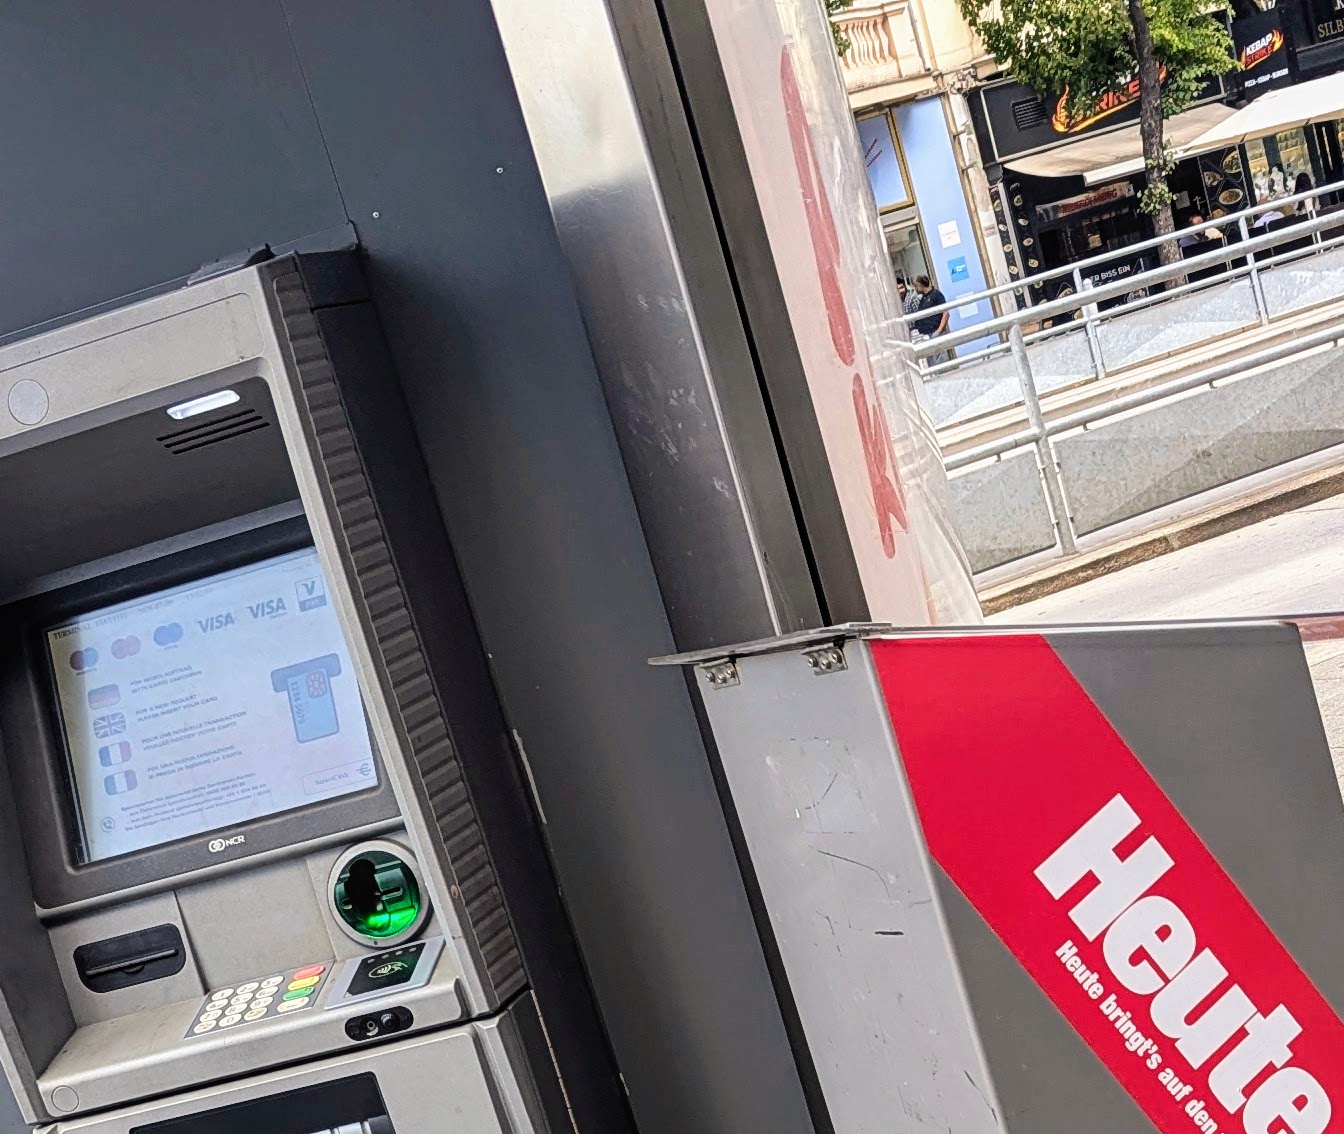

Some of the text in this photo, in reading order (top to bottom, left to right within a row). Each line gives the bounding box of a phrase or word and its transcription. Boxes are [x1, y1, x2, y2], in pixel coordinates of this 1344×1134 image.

[1246, 33, 1273, 57] KEBAP
[247, 596, 287, 620] VISA
[196, 612, 235, 634] VISA
[225, 834, 245, 847] NCR
[1055, 940, 1217, 1134] Heute bringt's auf den
